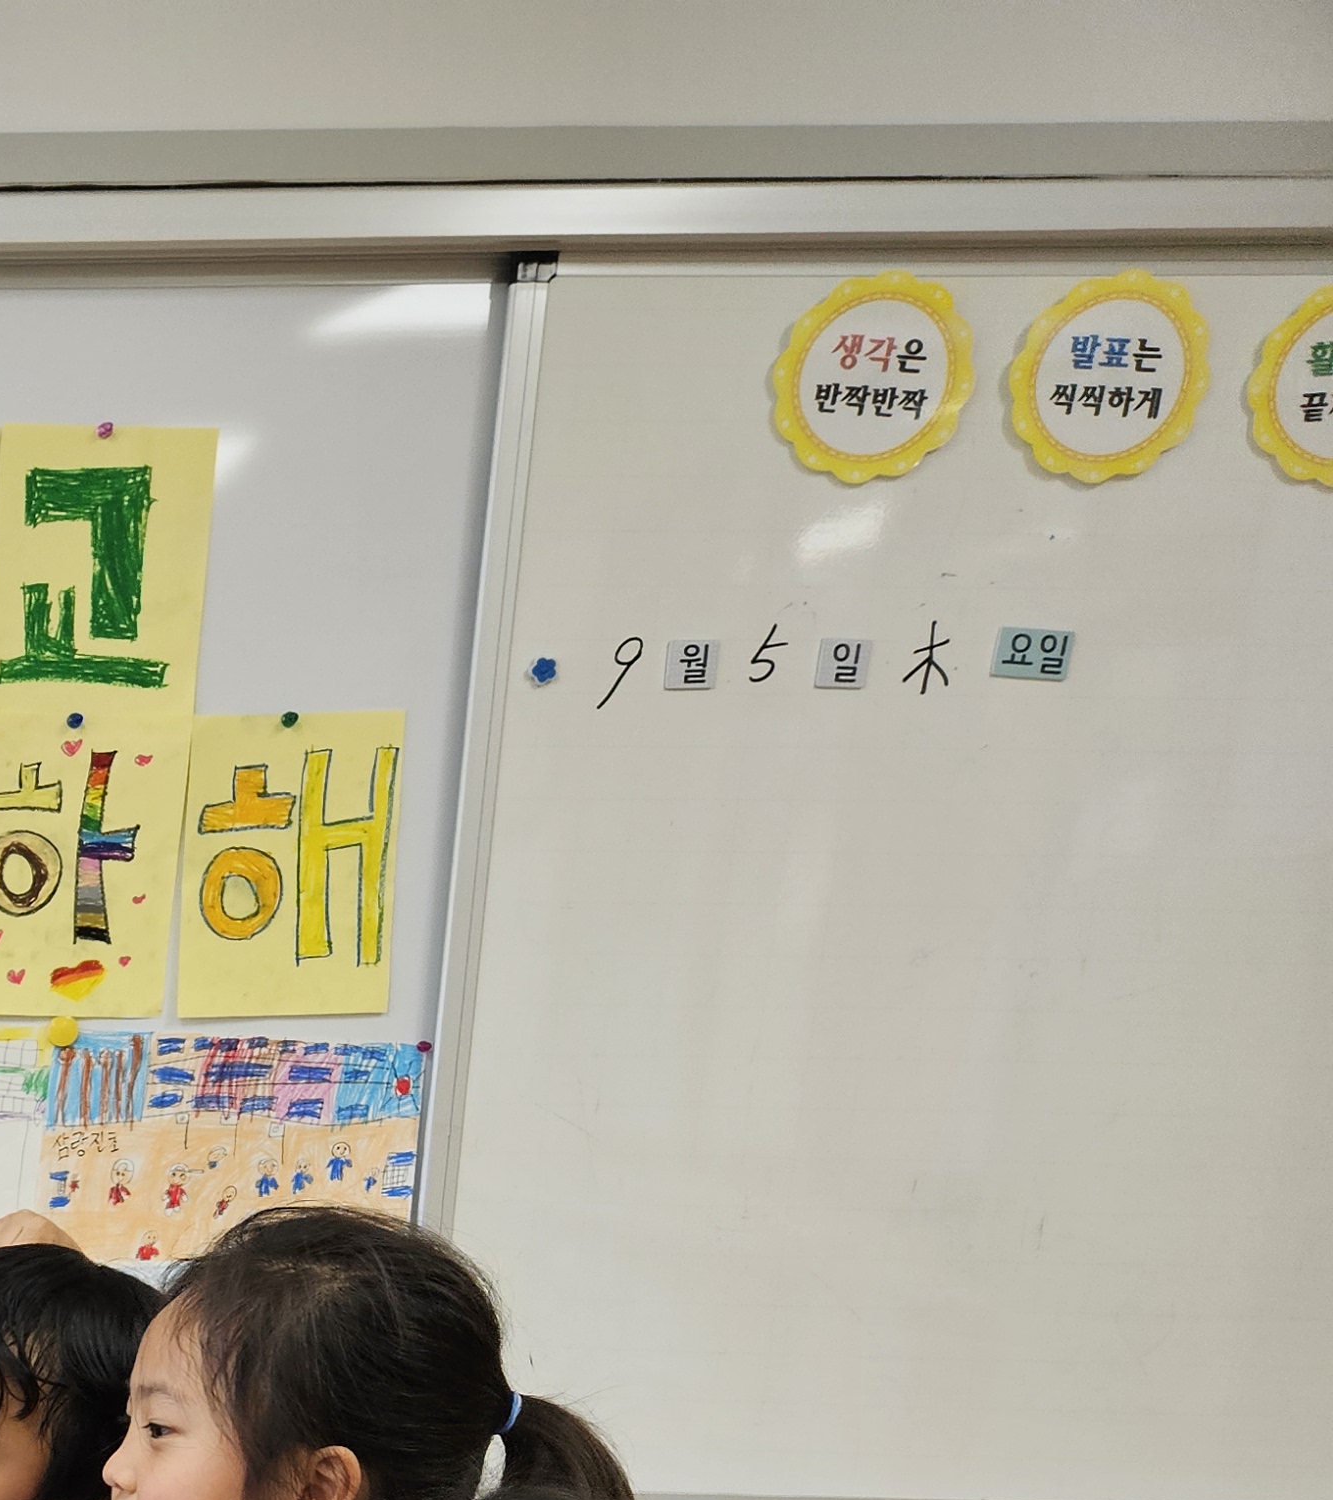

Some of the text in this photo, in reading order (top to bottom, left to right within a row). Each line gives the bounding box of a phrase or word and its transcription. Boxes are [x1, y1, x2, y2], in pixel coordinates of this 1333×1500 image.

[832, 334, 927, 374] 생각은
[1070, 334, 1162, 373] 발표는
[814, 382, 928, 421] 반짝반짝
[1049, 383, 1163, 420] 씩씩하게
[597, 636, 643, 709] 9
[679, 642, 712, 685] 월
[747, 623, 789, 684] 5
[831, 642, 863, 684] 일
[1001, 632, 1072, 676] 요일
